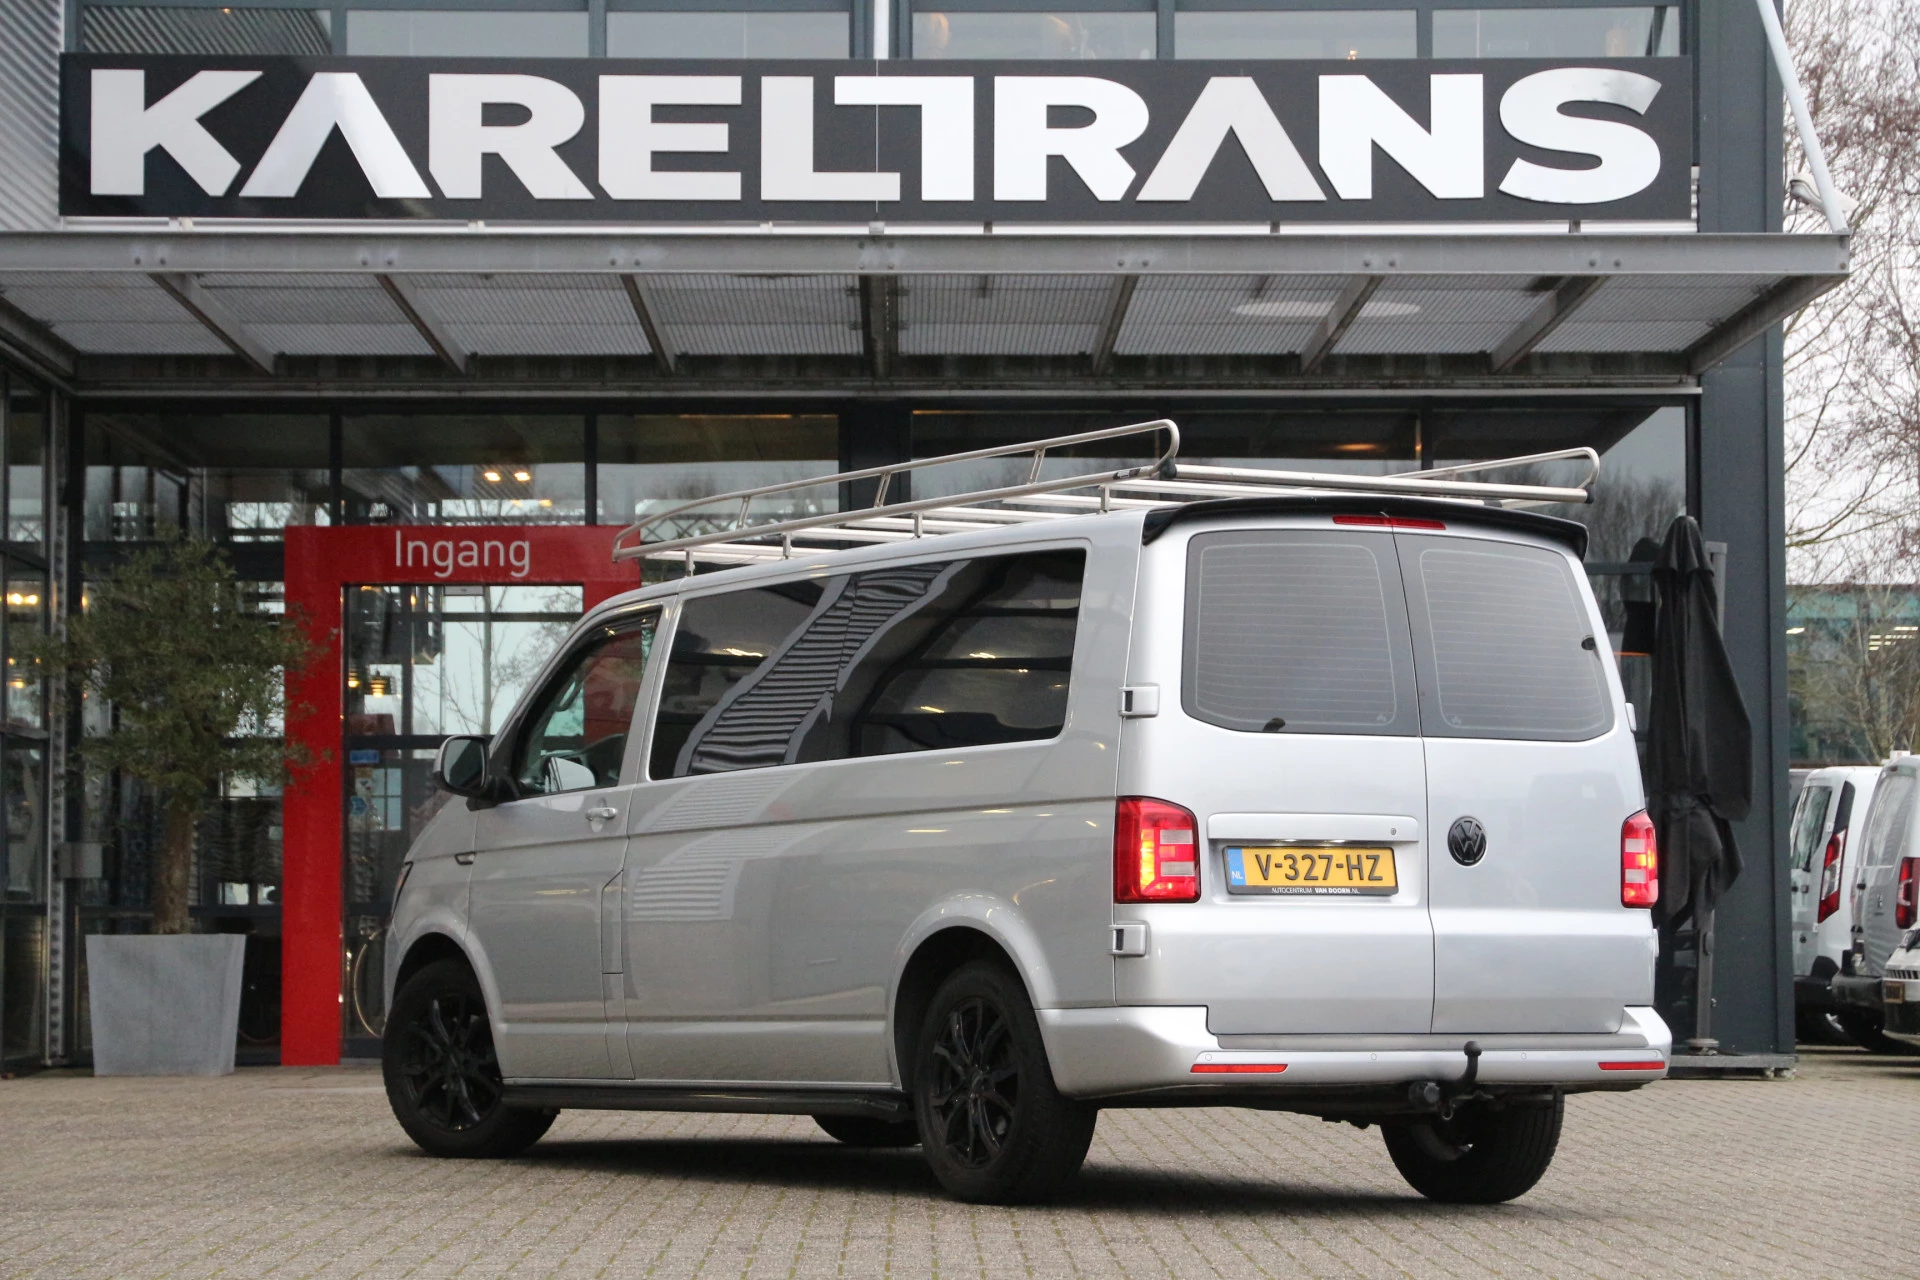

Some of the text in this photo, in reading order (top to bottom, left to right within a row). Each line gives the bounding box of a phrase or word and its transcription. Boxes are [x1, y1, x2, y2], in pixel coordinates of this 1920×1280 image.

[90, 67, 1663, 204] KARELTRANS
[395, 530, 531, 578] Ingang
[1231, 870, 1244, 880] NL
[1254, 853, 1384, 881] V-327-HZ
